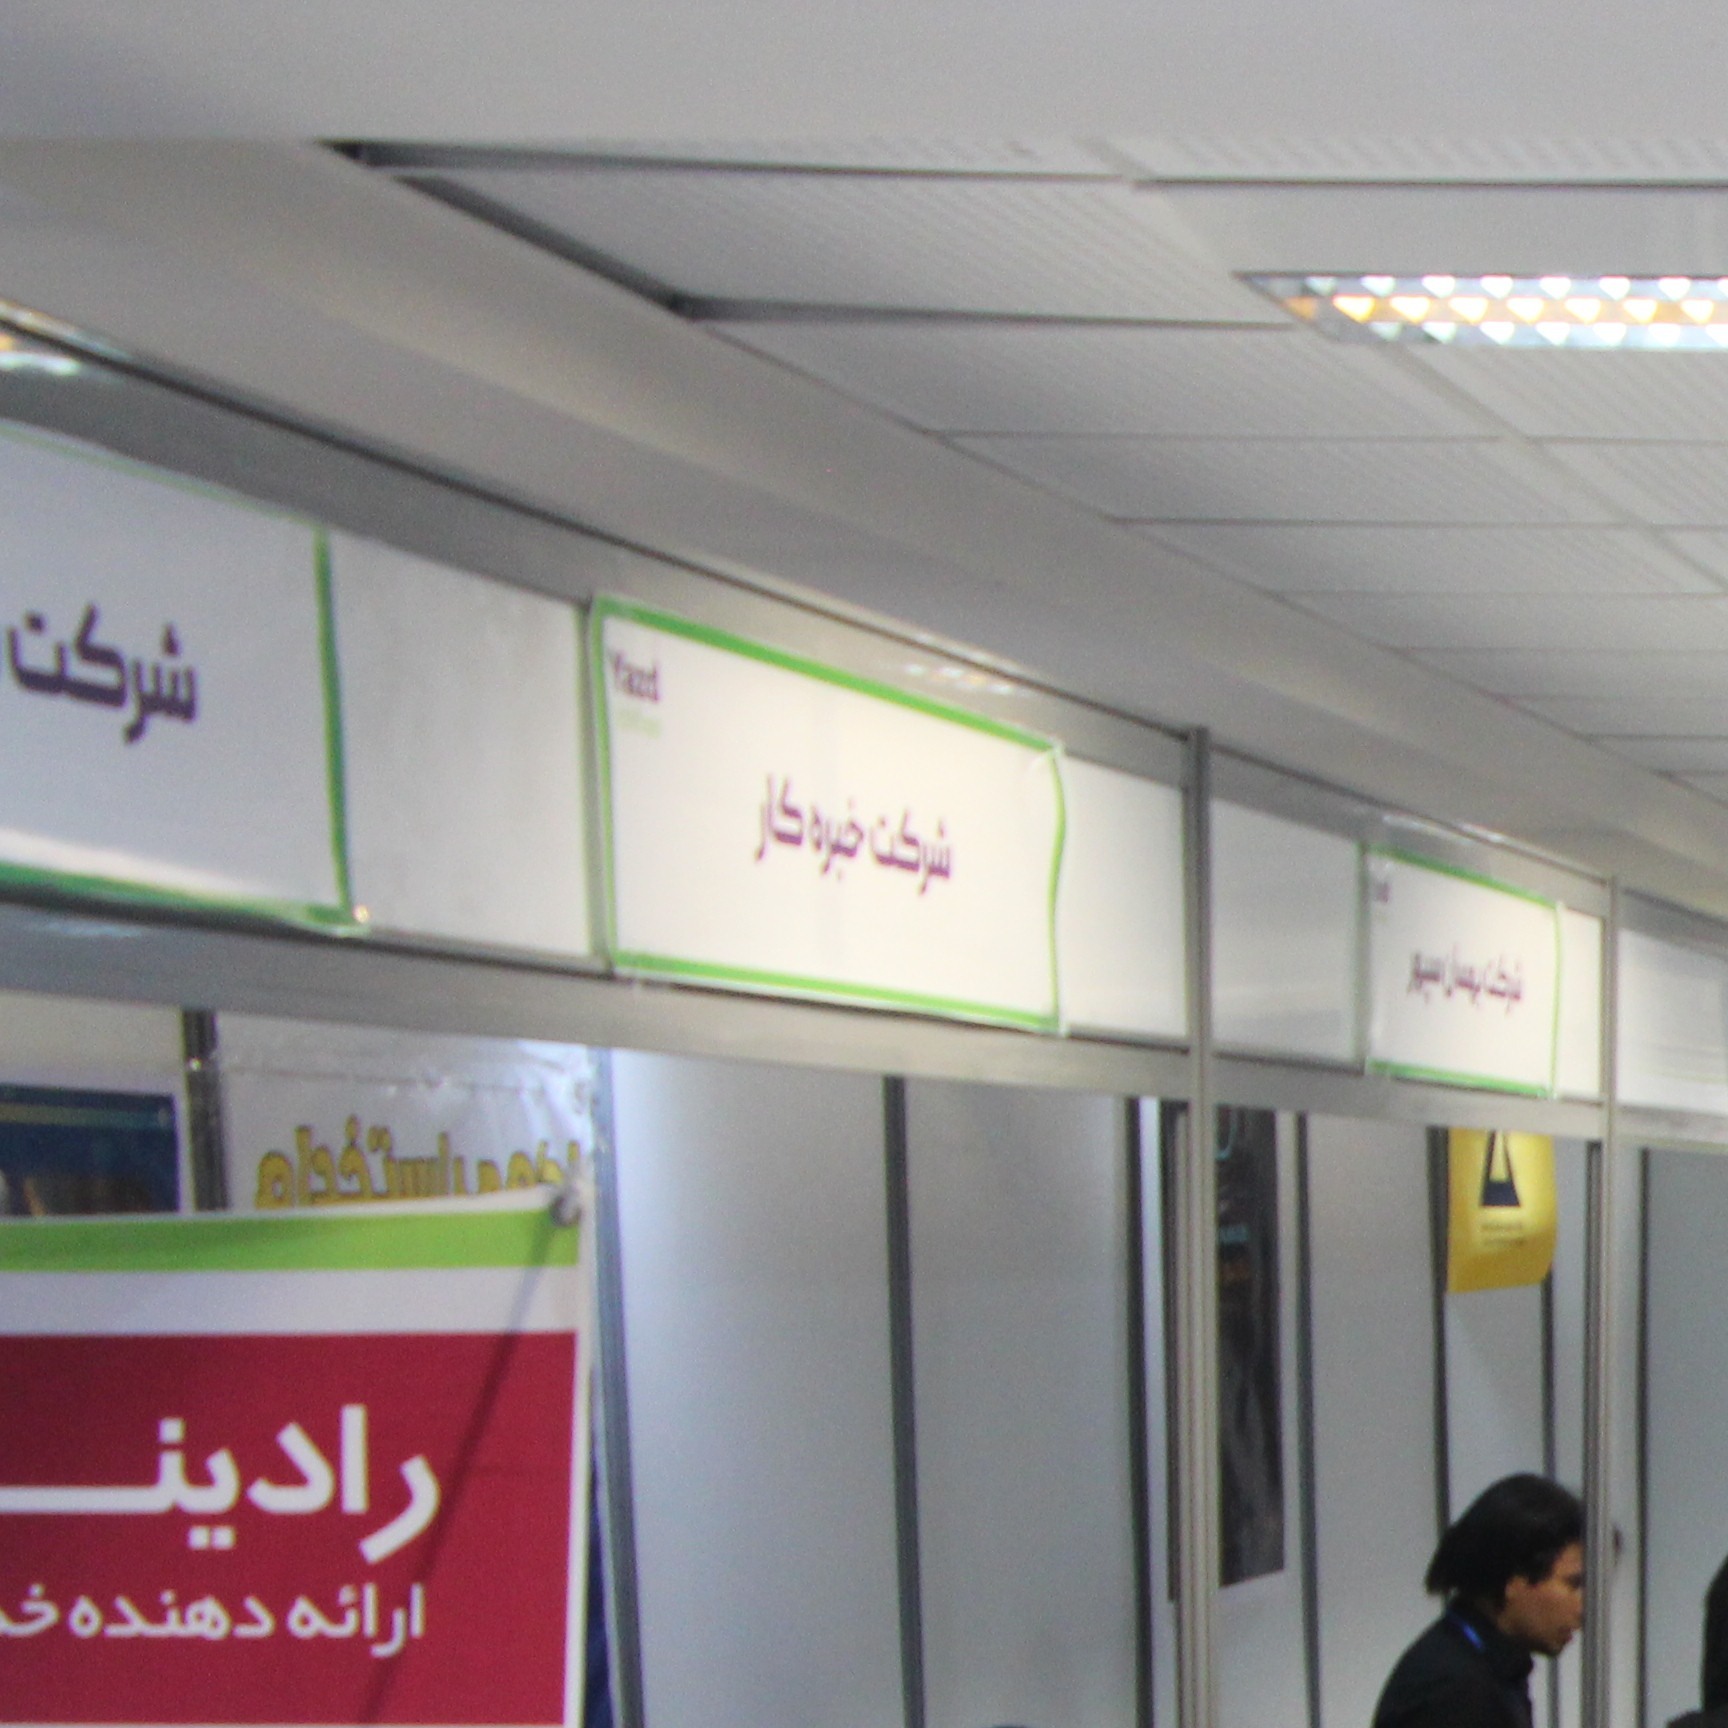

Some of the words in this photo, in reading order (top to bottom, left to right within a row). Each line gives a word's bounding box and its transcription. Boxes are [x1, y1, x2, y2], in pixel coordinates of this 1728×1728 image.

[6, 600, 198, 743] شرکت
[870, 806, 952, 897] شرکت
[67, 1588, 276, 1640] دهنده
[286, 1581, 427, 1659] ارائه
